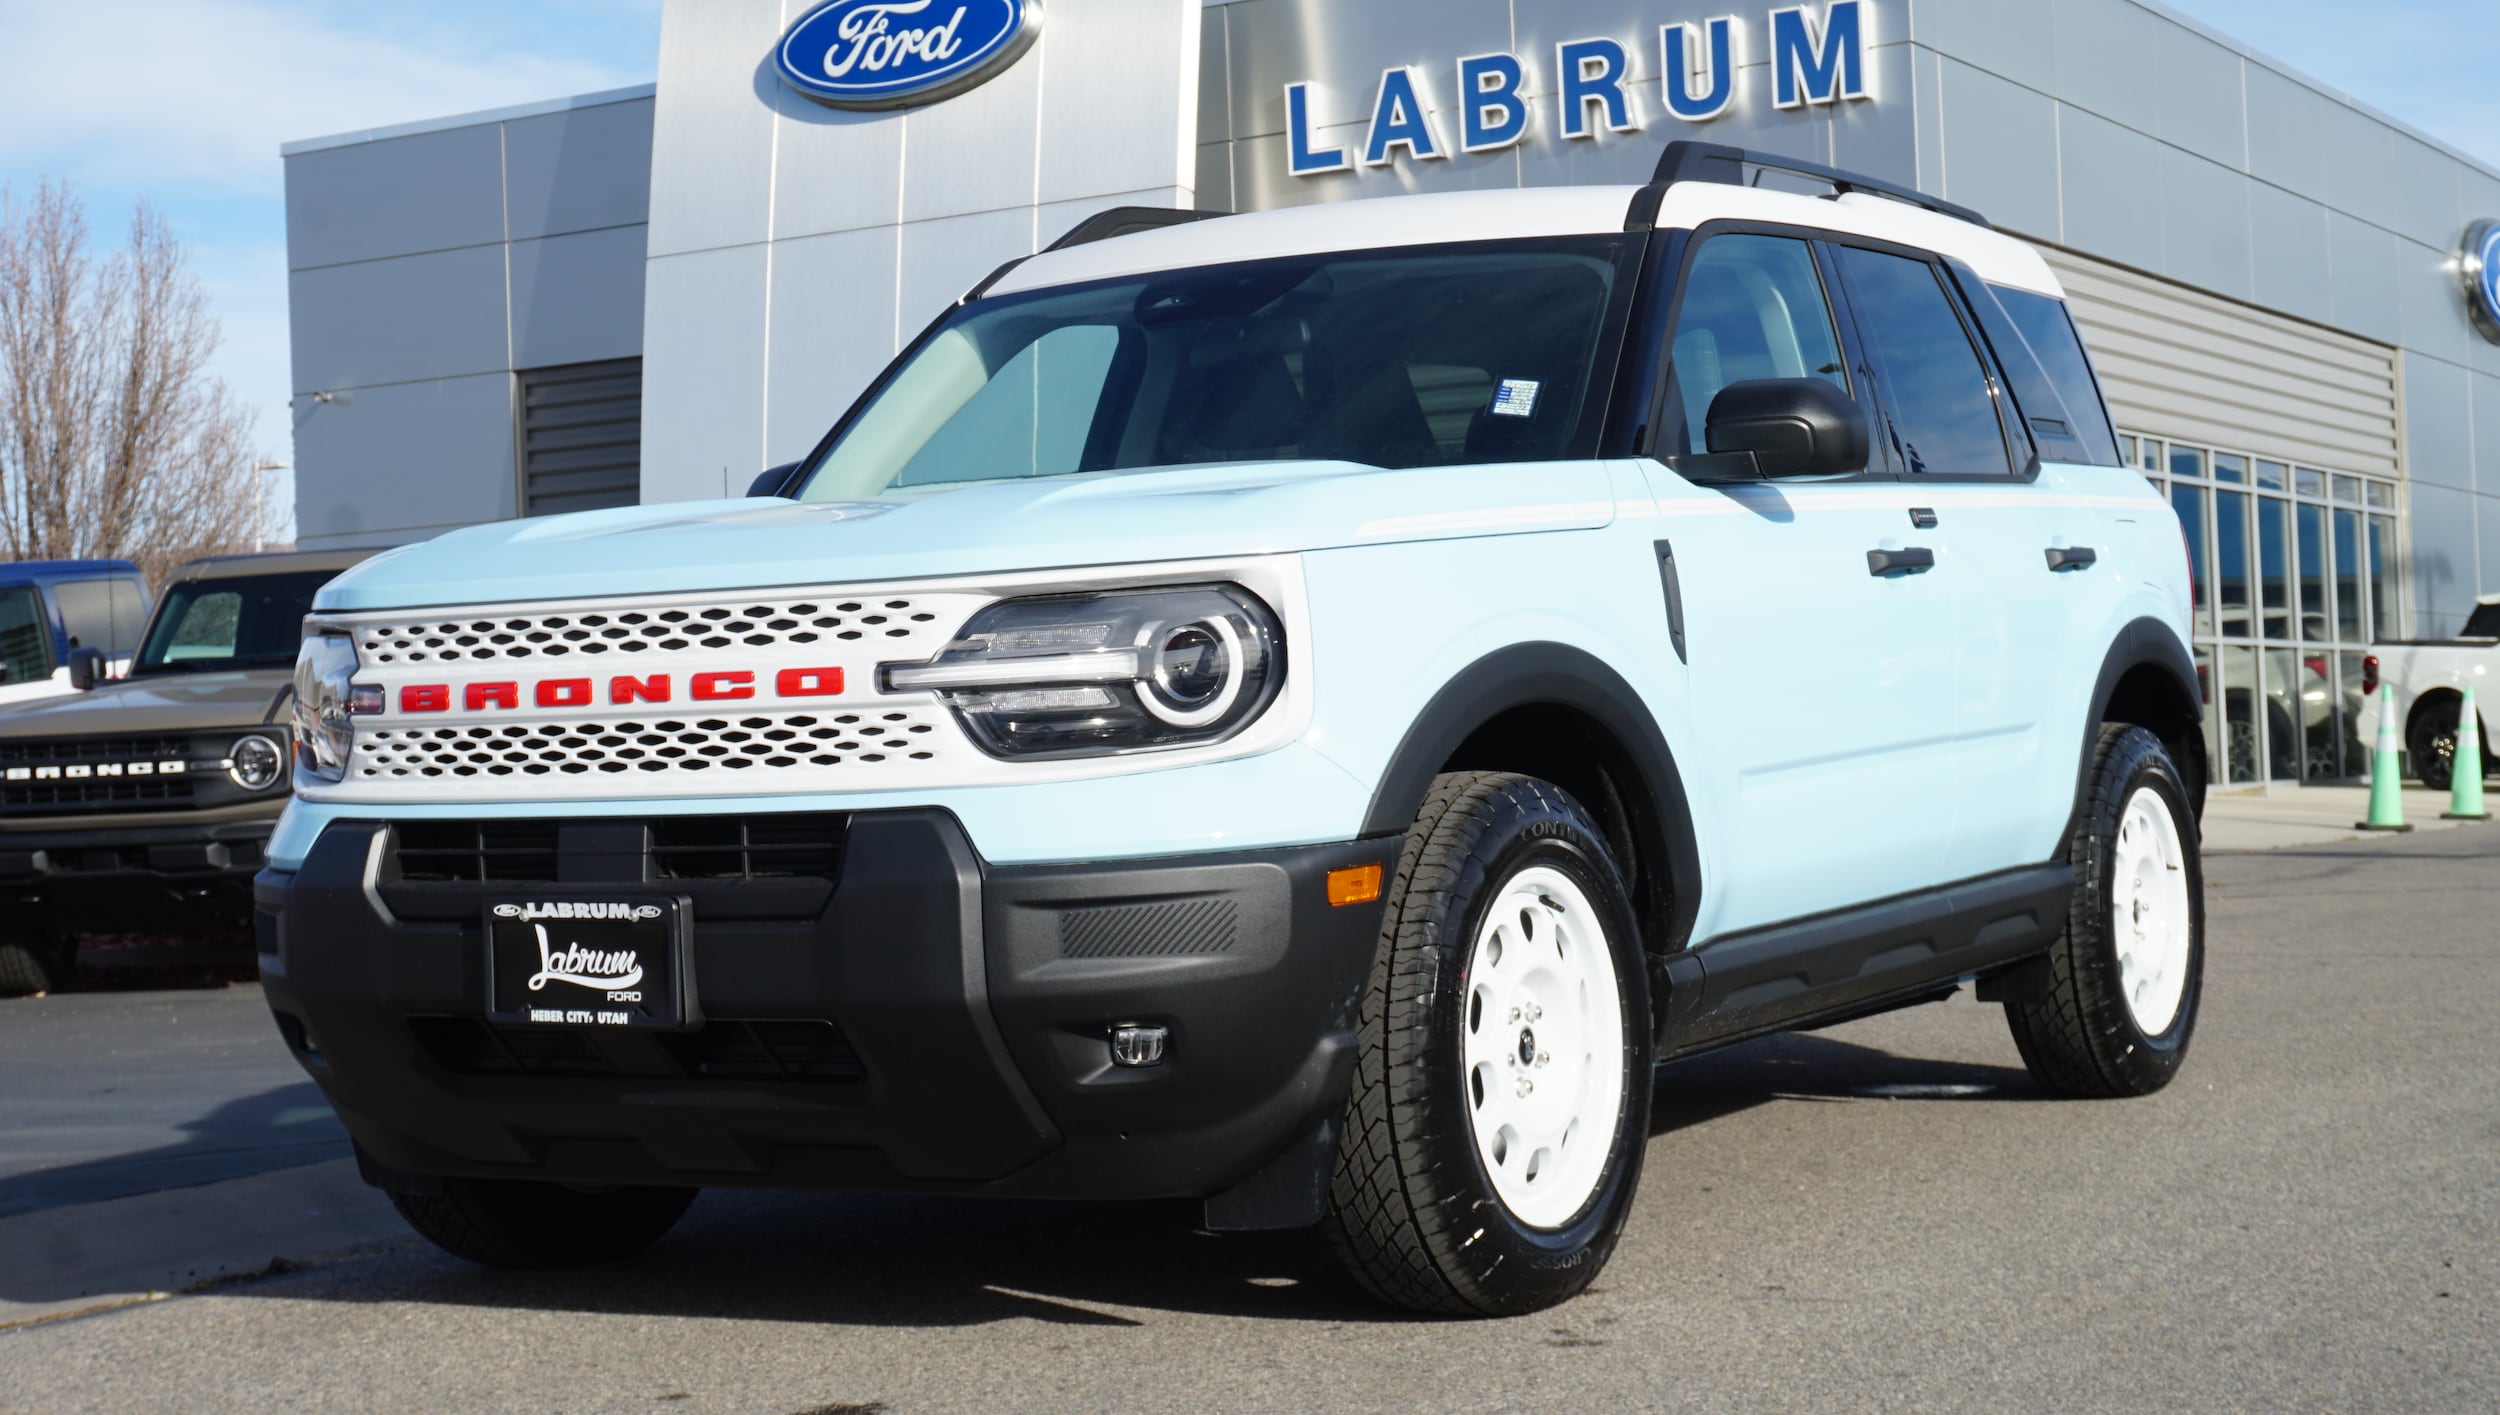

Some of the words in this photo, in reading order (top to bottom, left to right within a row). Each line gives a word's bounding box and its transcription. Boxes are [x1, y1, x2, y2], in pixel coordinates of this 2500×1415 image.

[823, 0, 967, 78] Ford
[1284, 0, 1874, 177] LABRUM
[399, 666, 845, 713] BRONCO
[6, 760, 185, 780] BRONCO
[526, 902, 630, 919] LABRUM
[528, 923, 643, 991] Labrum
[607, 991, 642, 1002] FORD
[531, 1009, 564, 1022] HEBER
[566, 1010, 594, 1024] CITY,
[597, 1012, 628, 1024] UTAH
